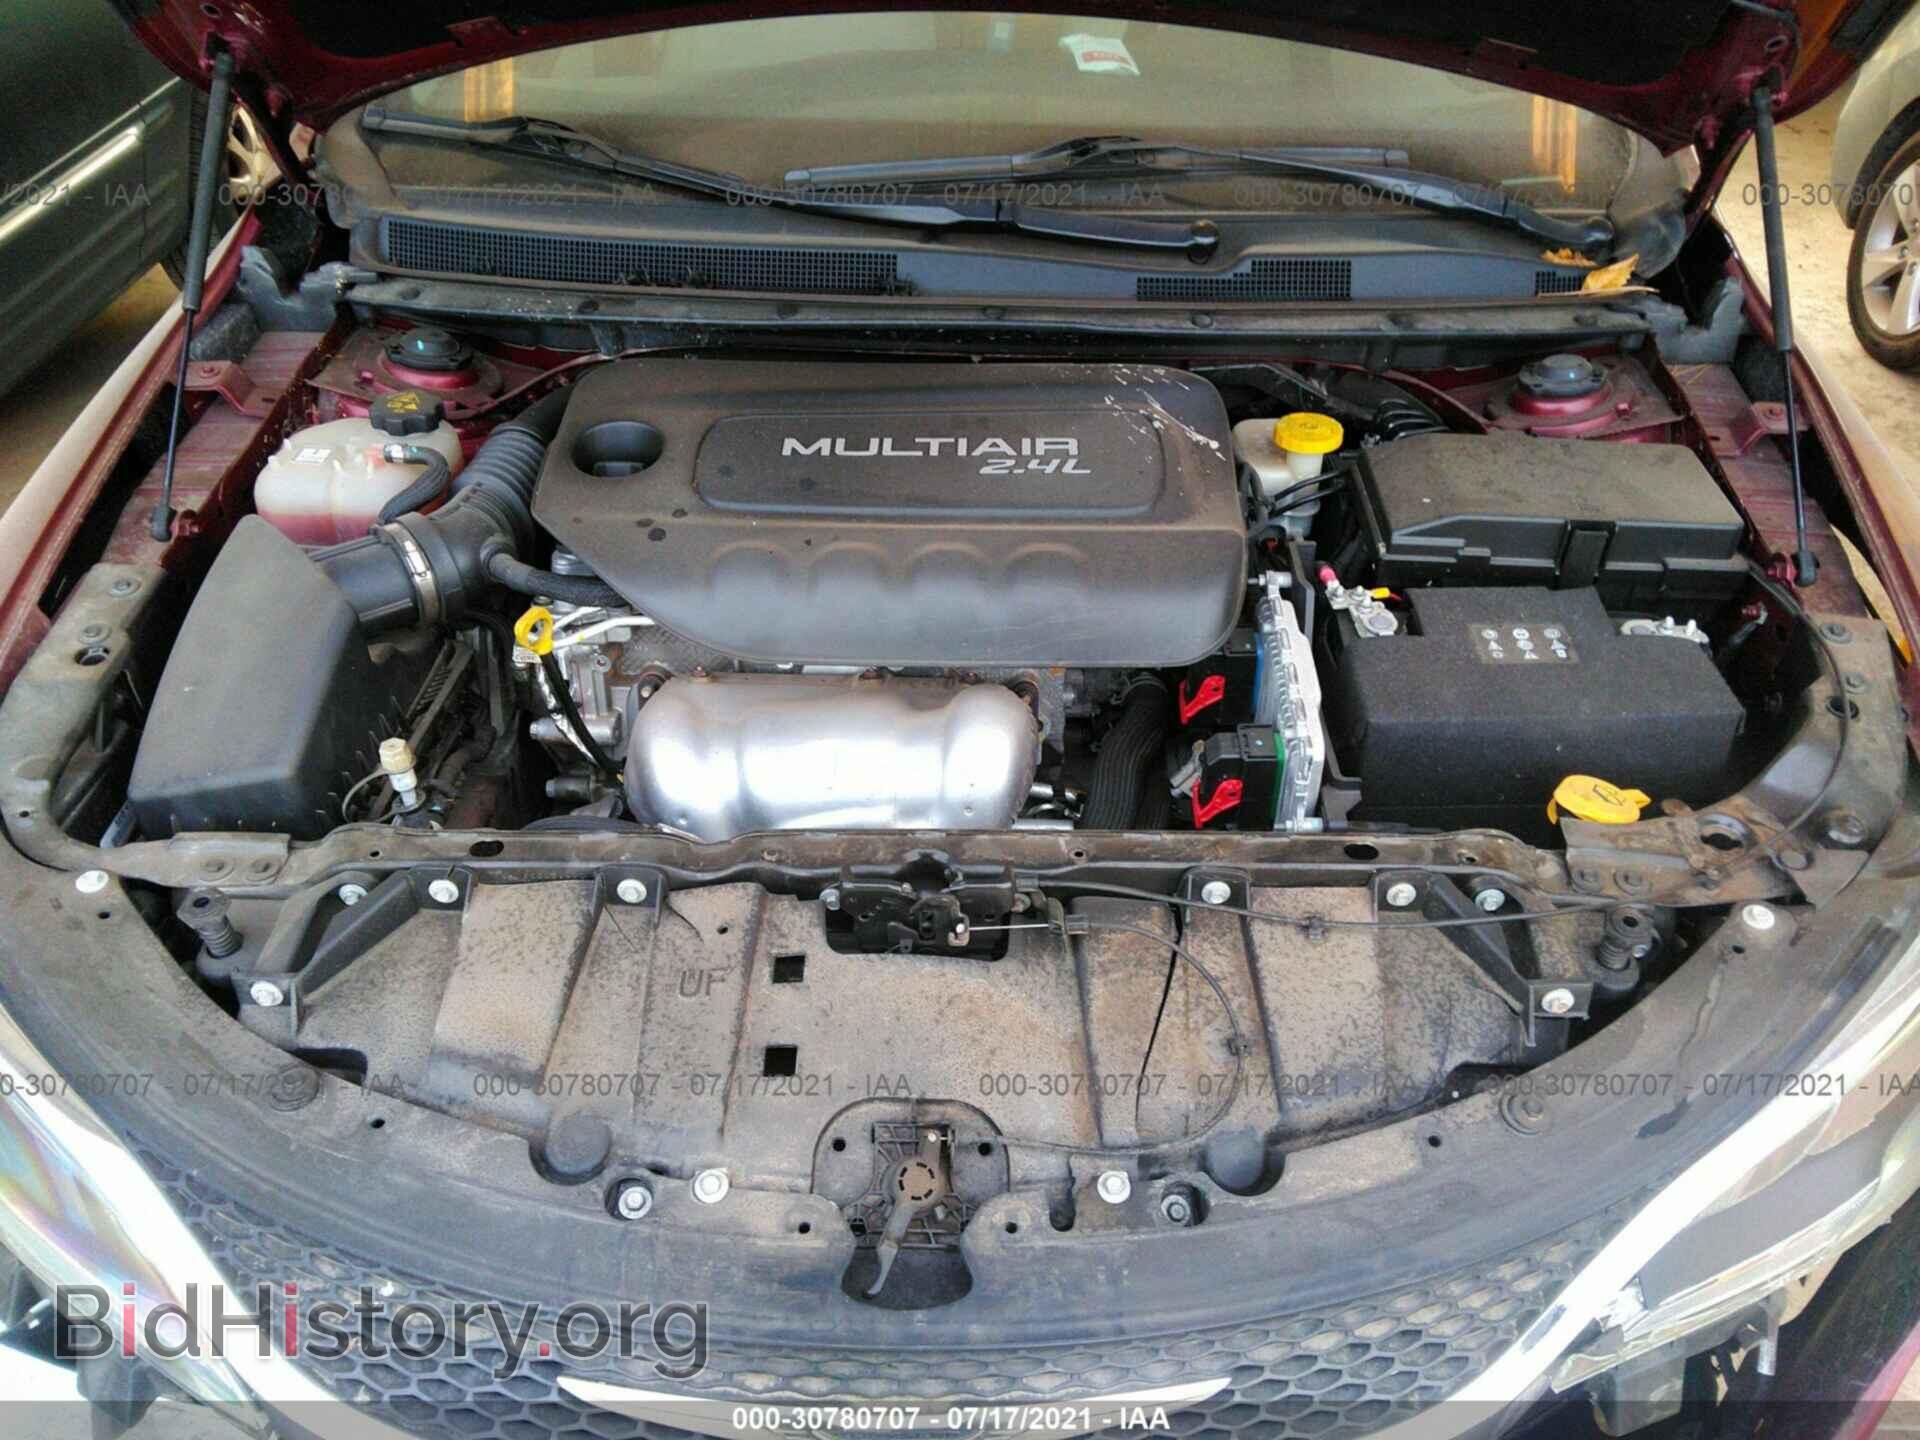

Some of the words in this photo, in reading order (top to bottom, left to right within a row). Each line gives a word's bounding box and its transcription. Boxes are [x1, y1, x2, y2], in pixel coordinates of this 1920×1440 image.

[782, 437, 1079, 457] MULTIAIR
[979, 458, 1092, 474] 2.4L
[679, 967, 730, 998] UF
